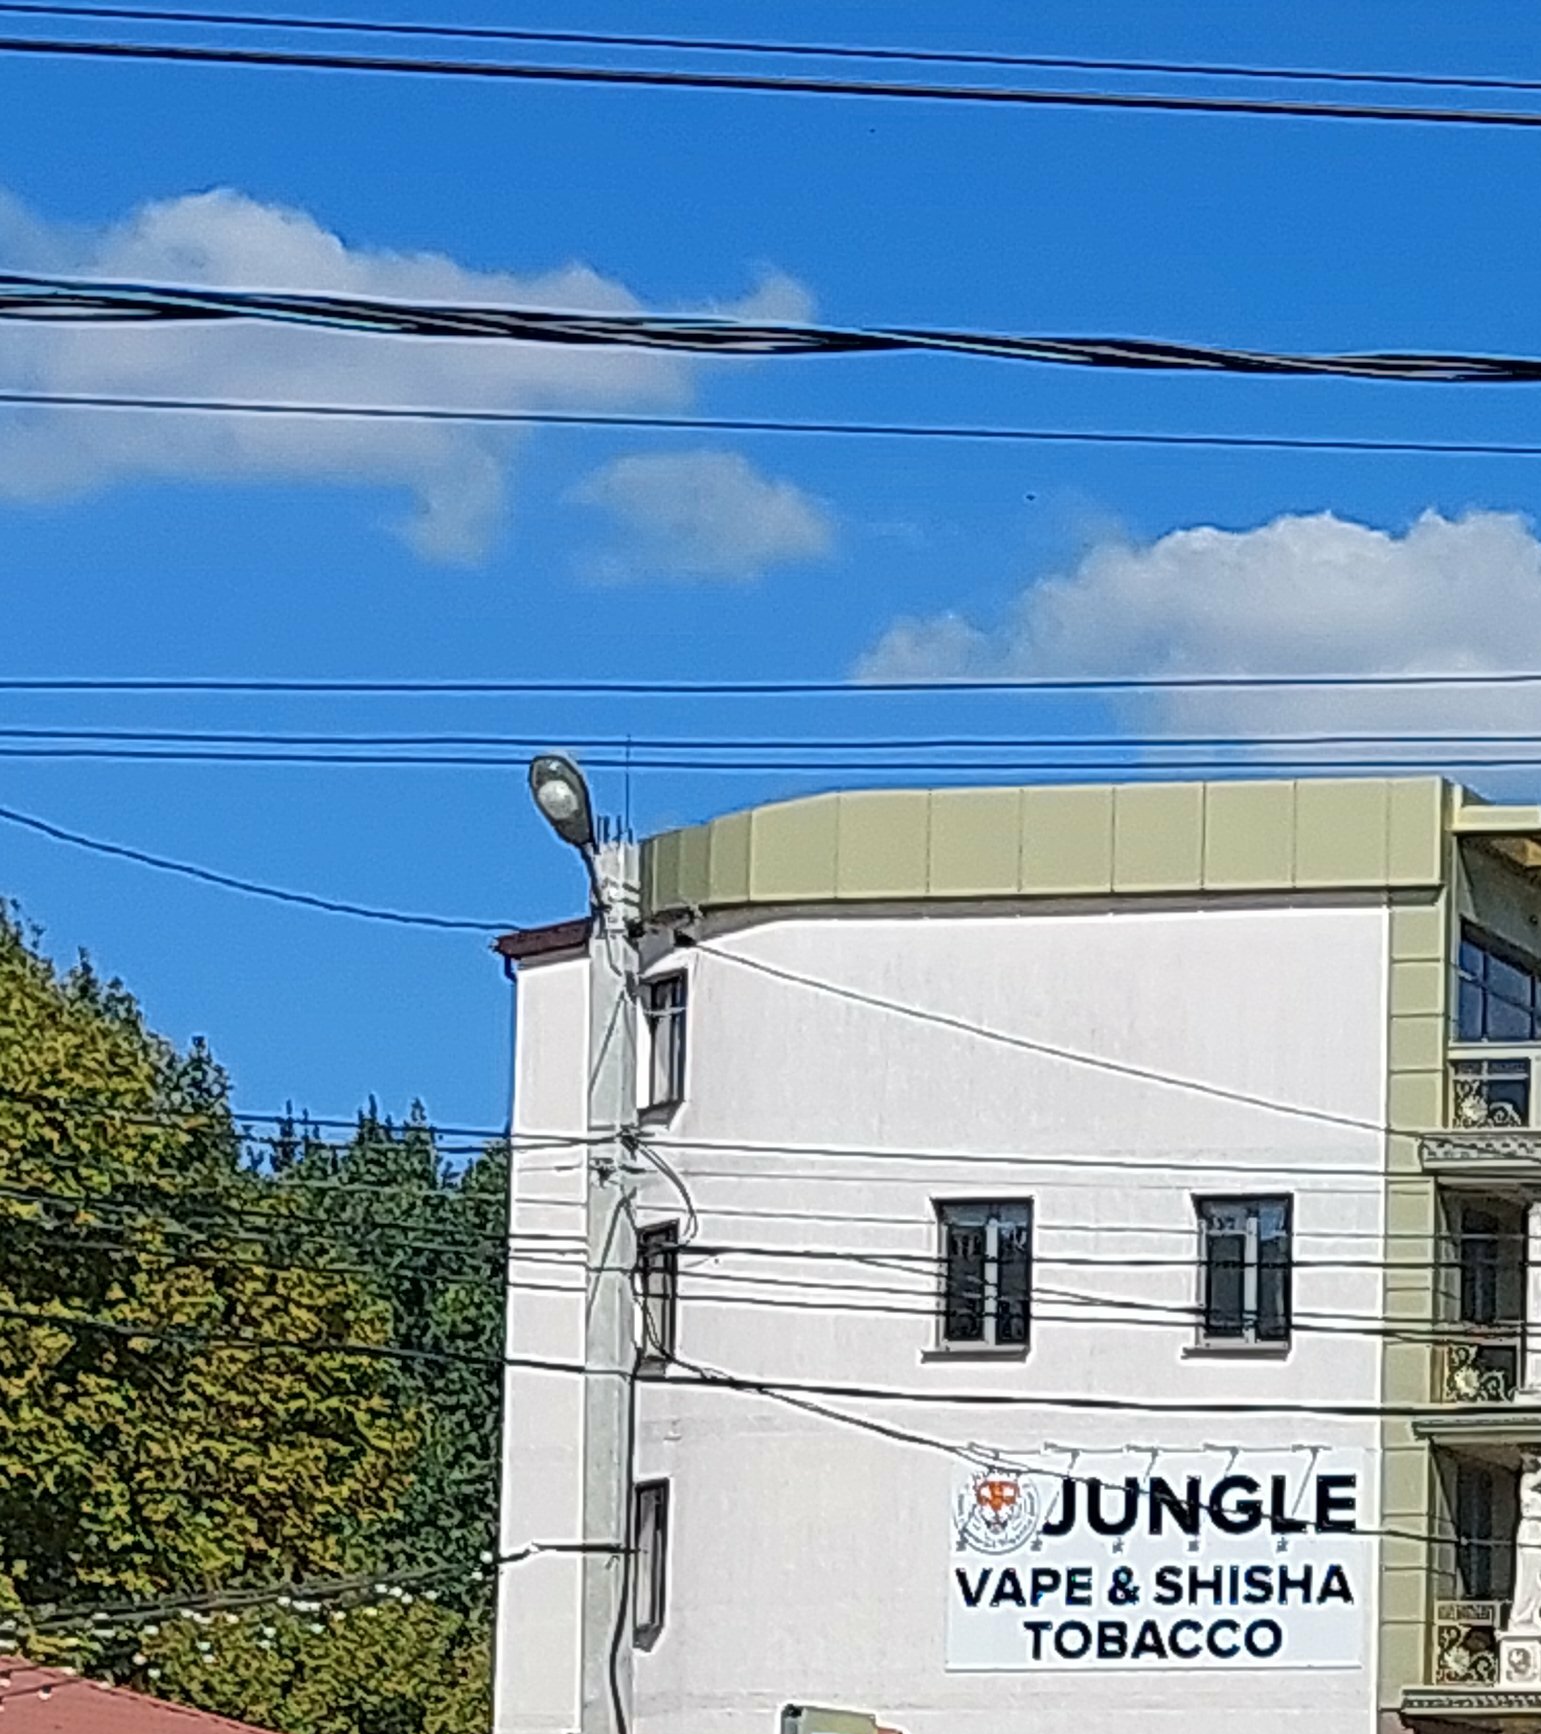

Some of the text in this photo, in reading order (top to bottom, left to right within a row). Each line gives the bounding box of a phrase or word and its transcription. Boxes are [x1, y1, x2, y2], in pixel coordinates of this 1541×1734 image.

[1042, 1474, 1357, 1536] JUNGLE
[955, 1565, 1355, 1606] VAPE & SHISHA
[1023, 1619, 1283, 1660] TOBACCO
